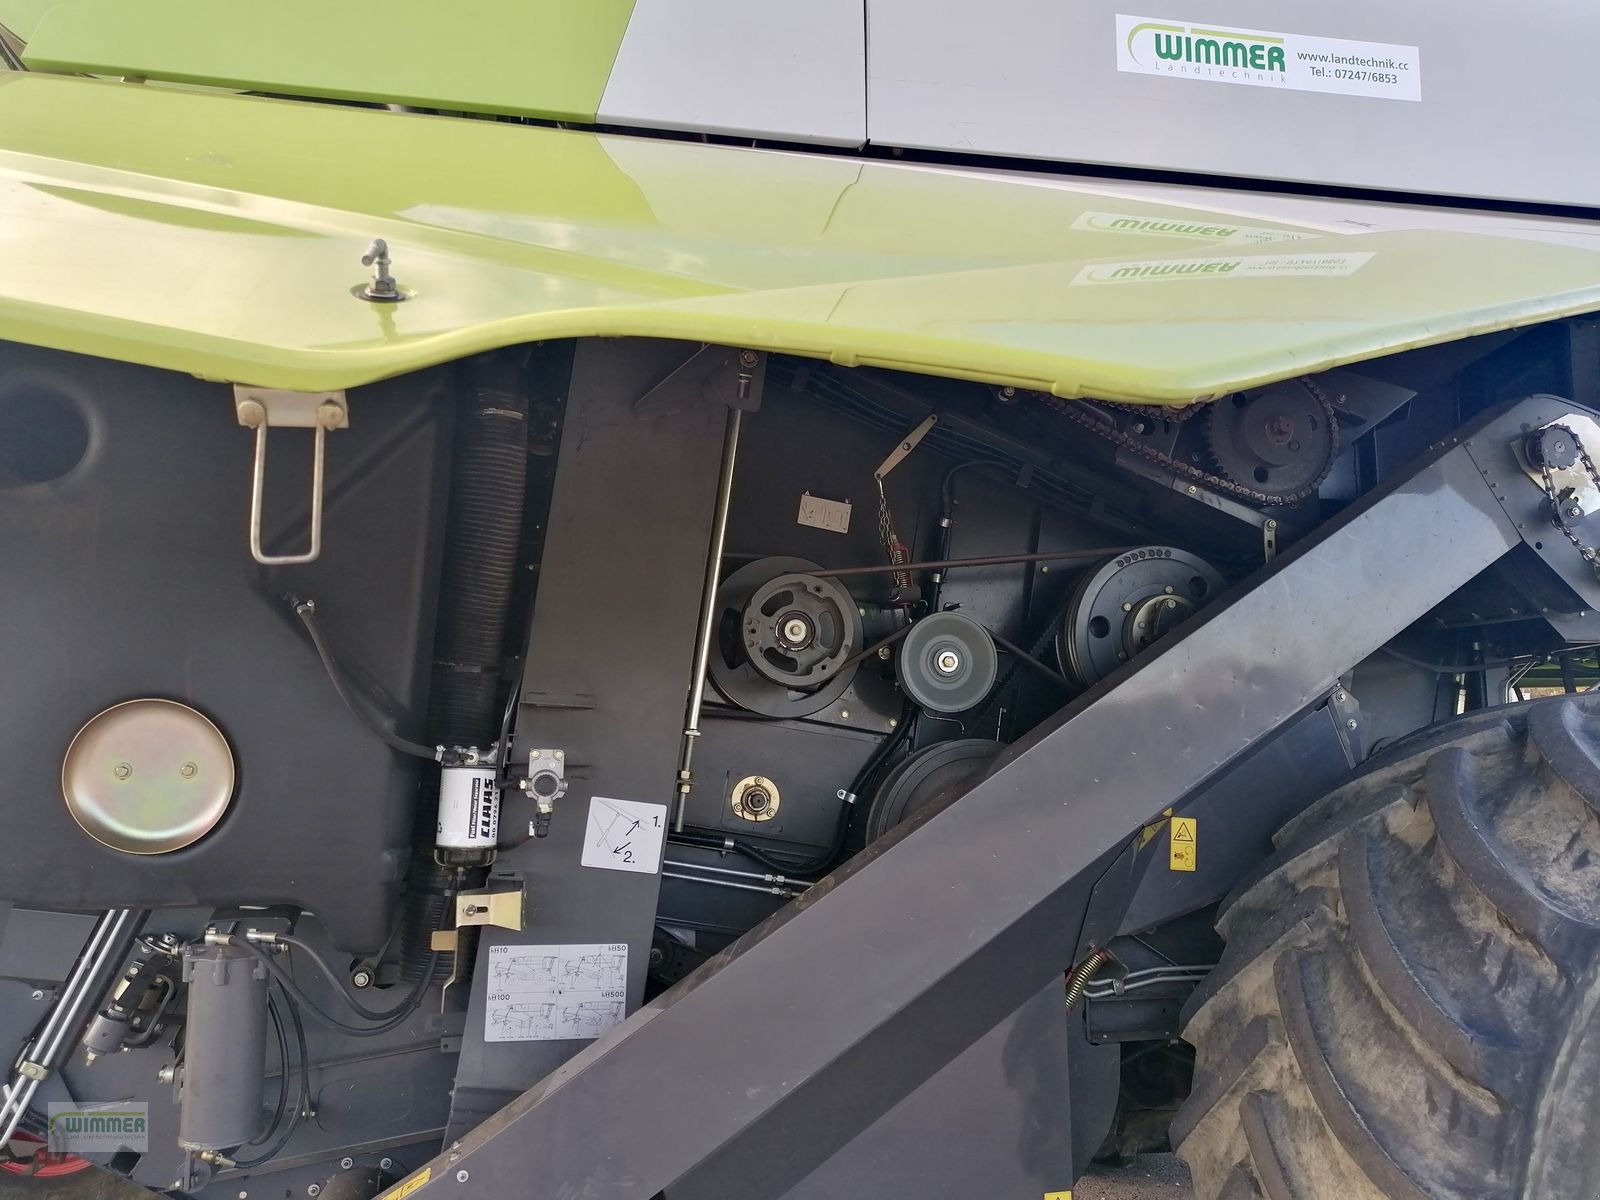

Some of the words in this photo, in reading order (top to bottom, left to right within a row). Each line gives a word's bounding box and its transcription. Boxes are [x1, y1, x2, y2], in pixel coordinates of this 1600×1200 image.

[1154, 33, 1286, 72] WIMMER
[1297, 51, 1409, 71] www.landtechnik.cc
[1155, 61, 1287, 83] Landtechnik
[1309, 66, 1332, 78] Tel.:
[1334, 68, 1398, 84] 07247/6853
[481, 778, 494, 838] CLAAS
[652, 815, 661, 828] 1.
[623, 850, 635, 864] 2.
